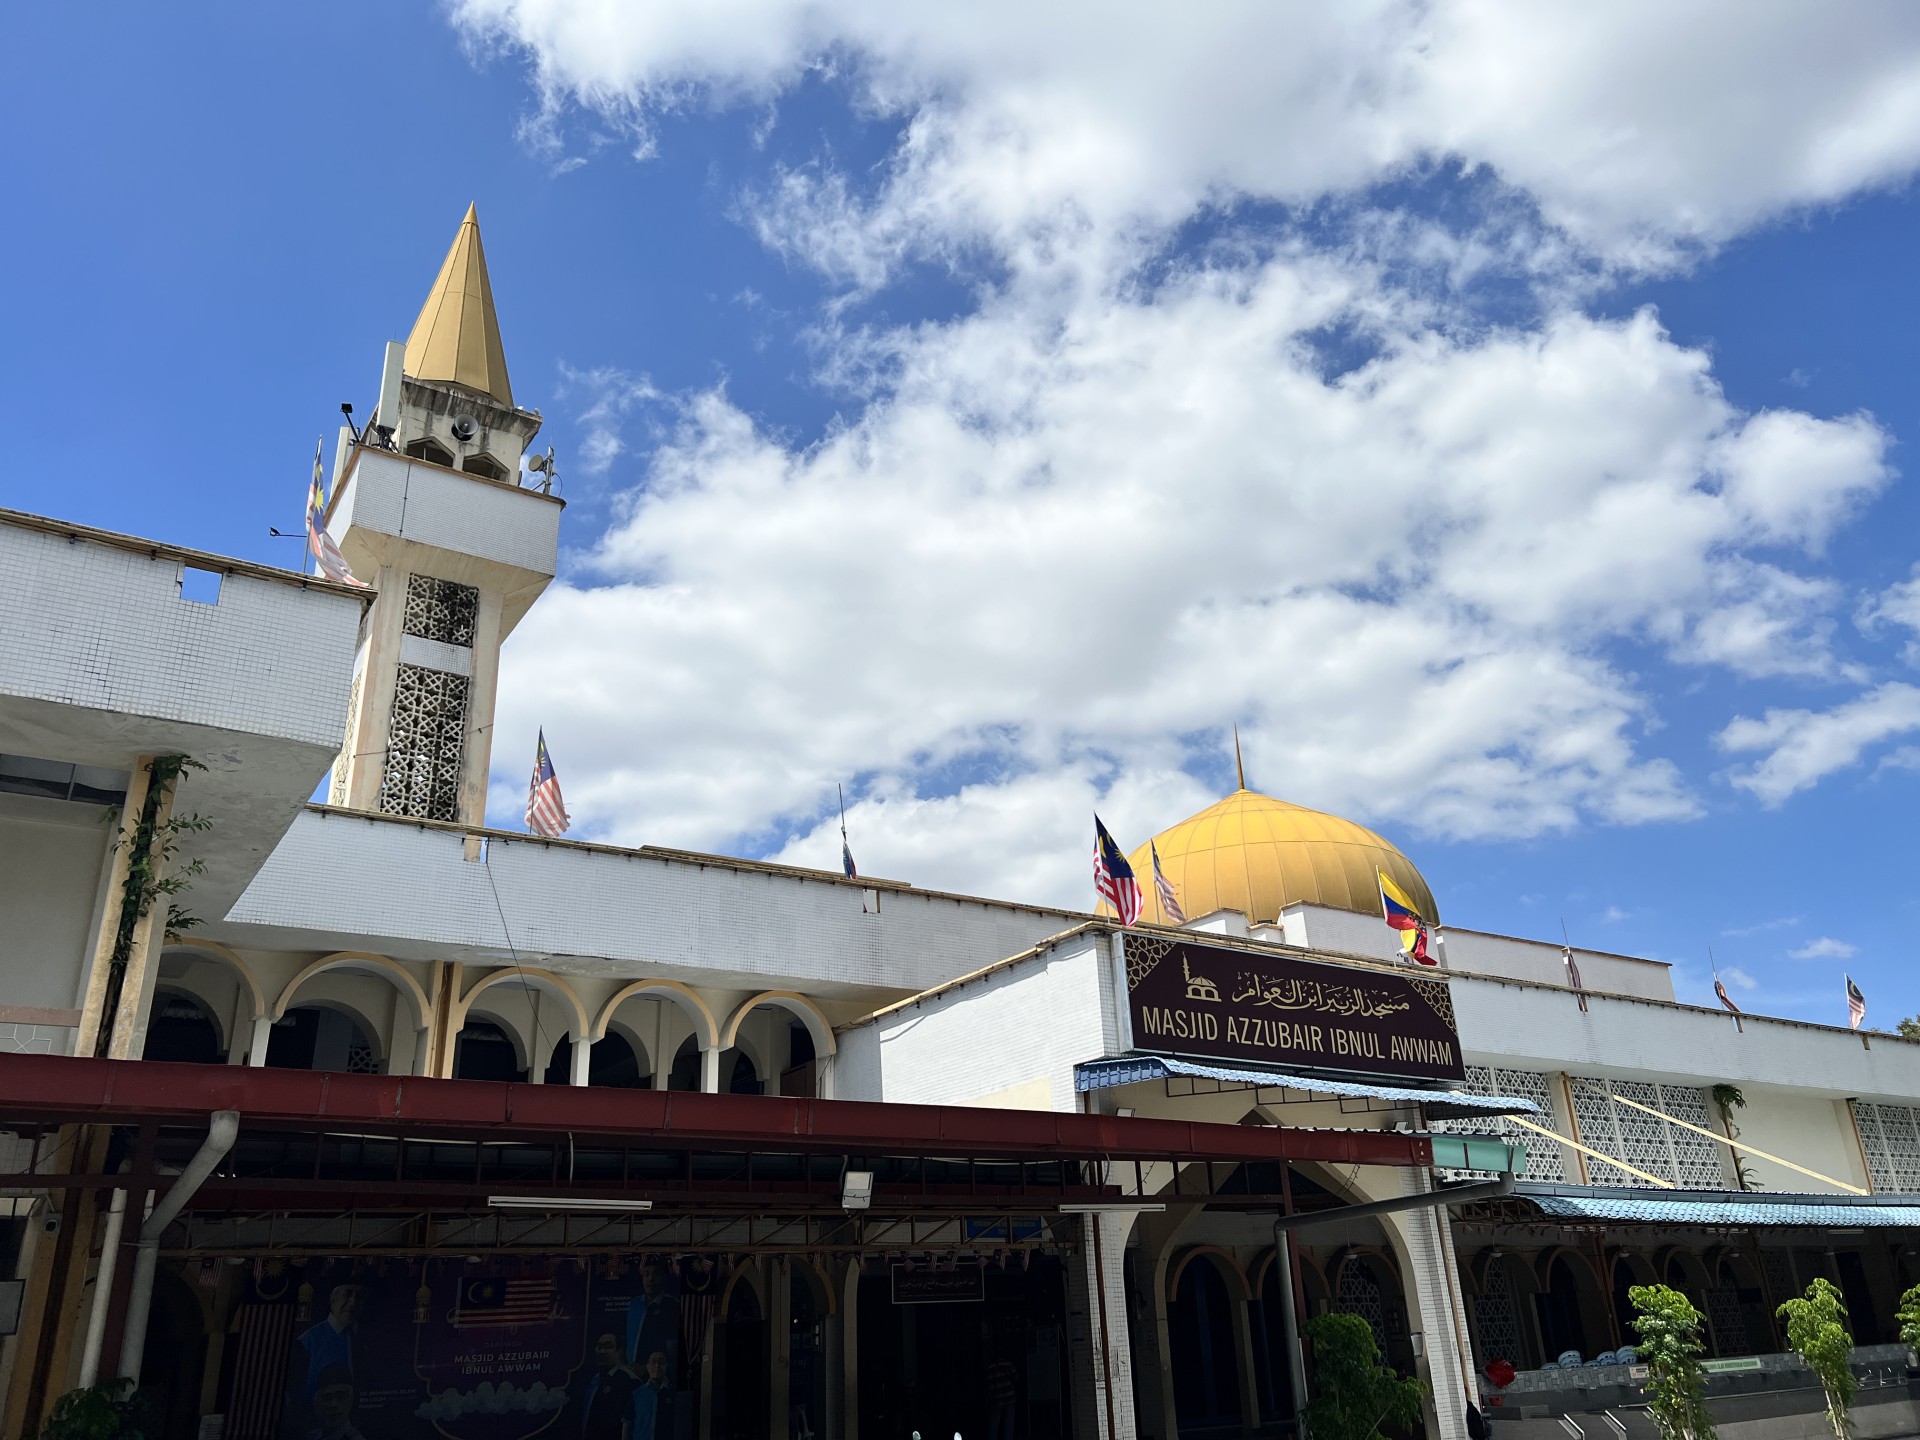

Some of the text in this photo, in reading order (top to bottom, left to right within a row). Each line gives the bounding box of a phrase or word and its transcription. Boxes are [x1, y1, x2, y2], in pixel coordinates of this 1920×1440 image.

[1360, 991, 1410, 1019] مسجد
[1142, 1006, 1453, 1066] MASJID AZZUBAIR IBNUL AWWAM
[454, 1350, 550, 1364] MASJID AZZUBAIR
[462, 1362, 541, 1375] IBNUL AWWAM
